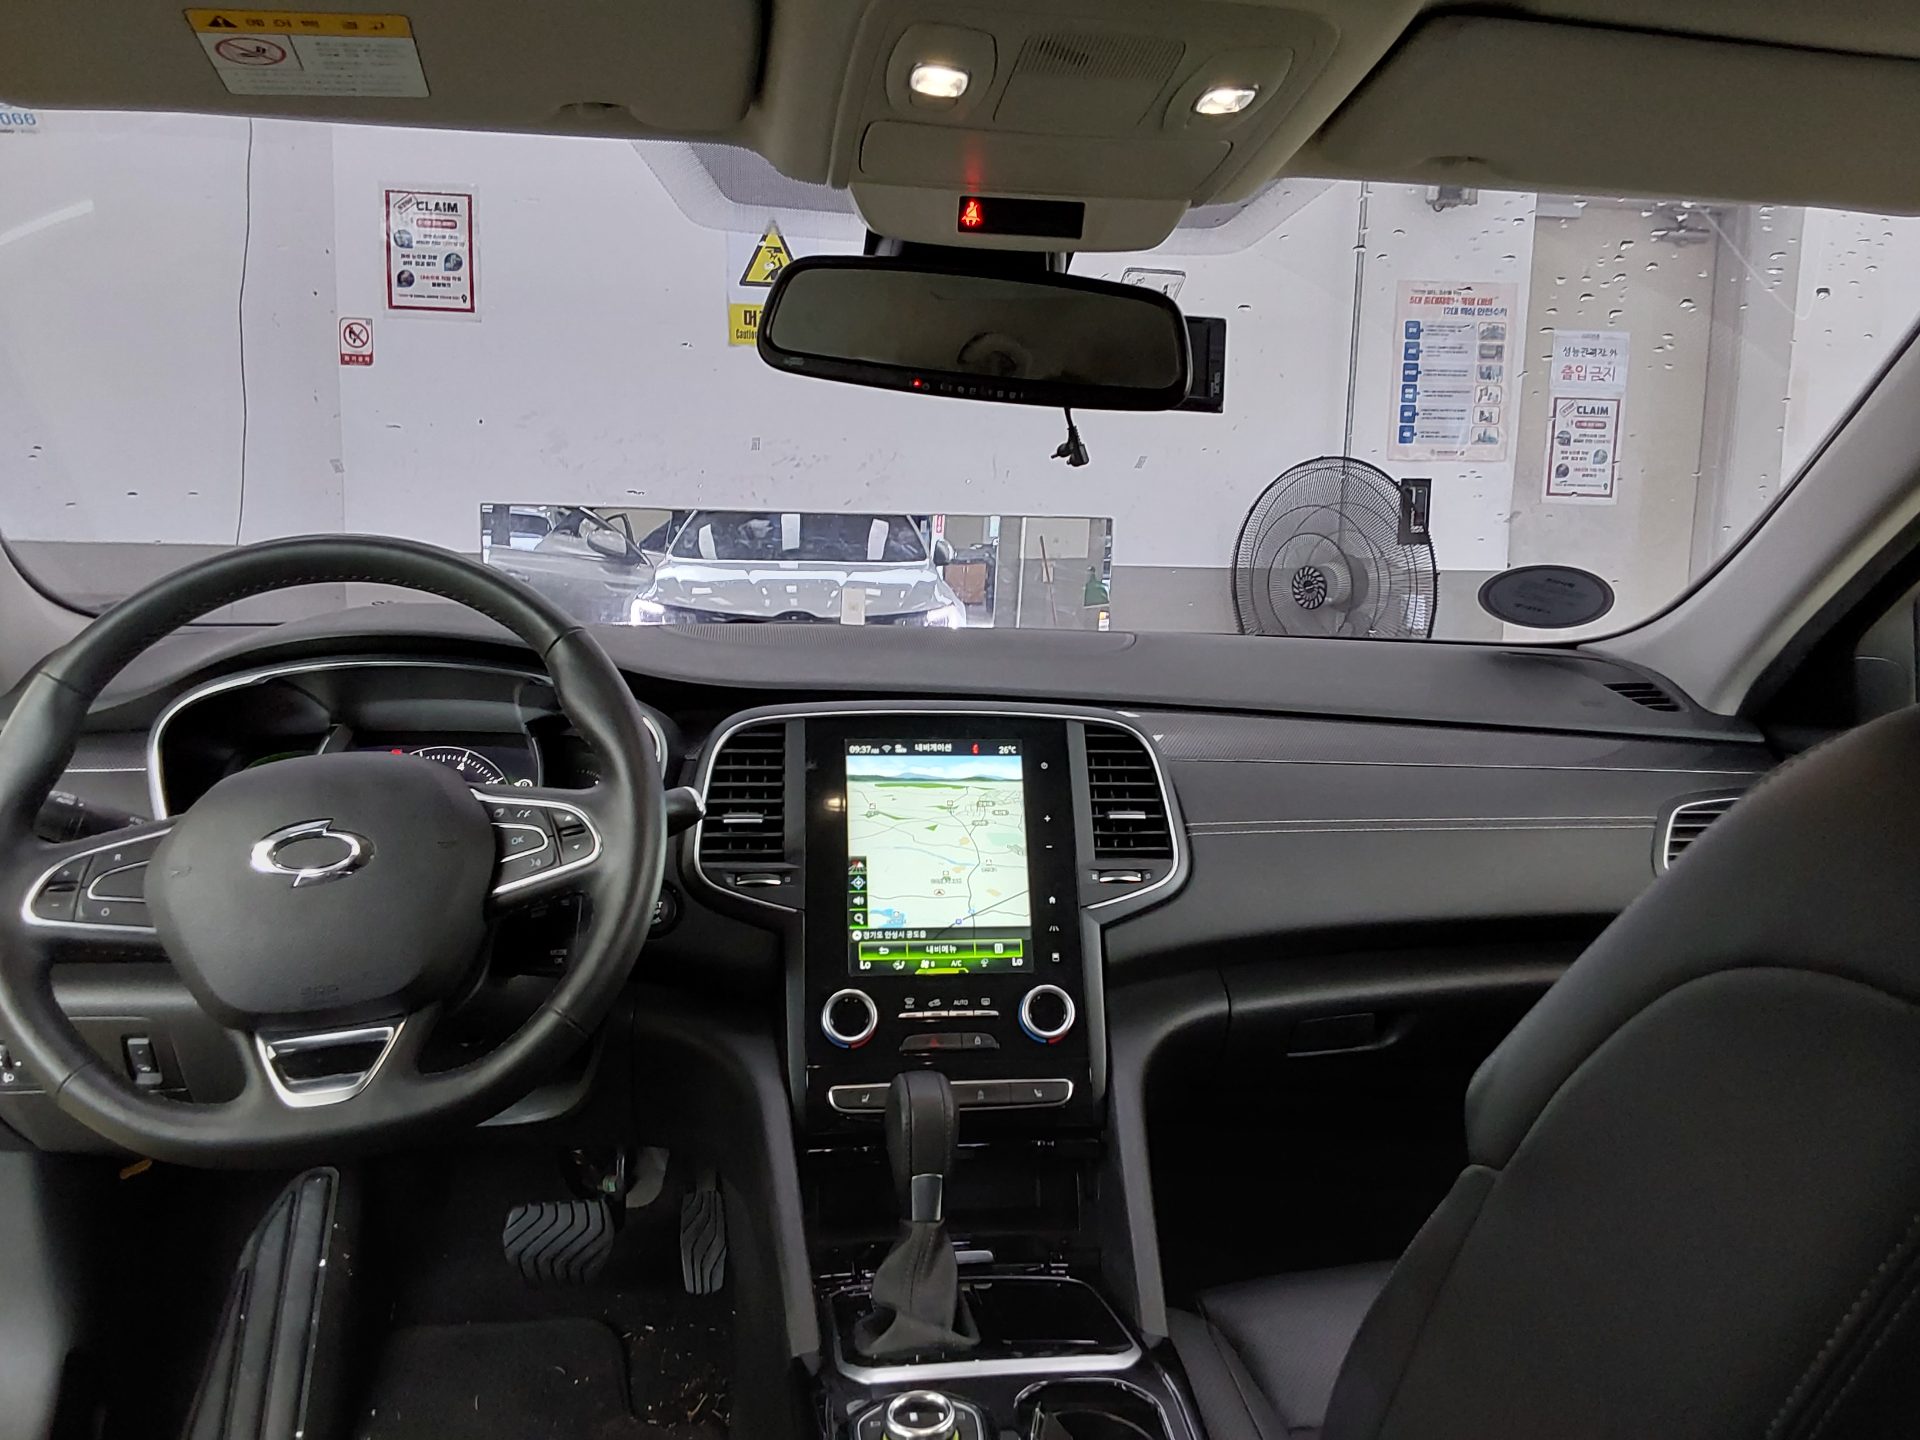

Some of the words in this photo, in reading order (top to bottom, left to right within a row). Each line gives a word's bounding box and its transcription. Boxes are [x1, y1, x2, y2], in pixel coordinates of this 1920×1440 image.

[416, 201, 459, 213] CLAIM
[1561, 365, 1616, 382] 출입금지
[1576, 406, 1609, 415] CLAIM
[914, 743, 952, 752] 내비게이션
[511, 836, 524, 845] OK
[862, 932, 884, 940] 경기도
[885, 931, 905, 939] 안성시
[926, 944, 957, 954] 내비메뉴
